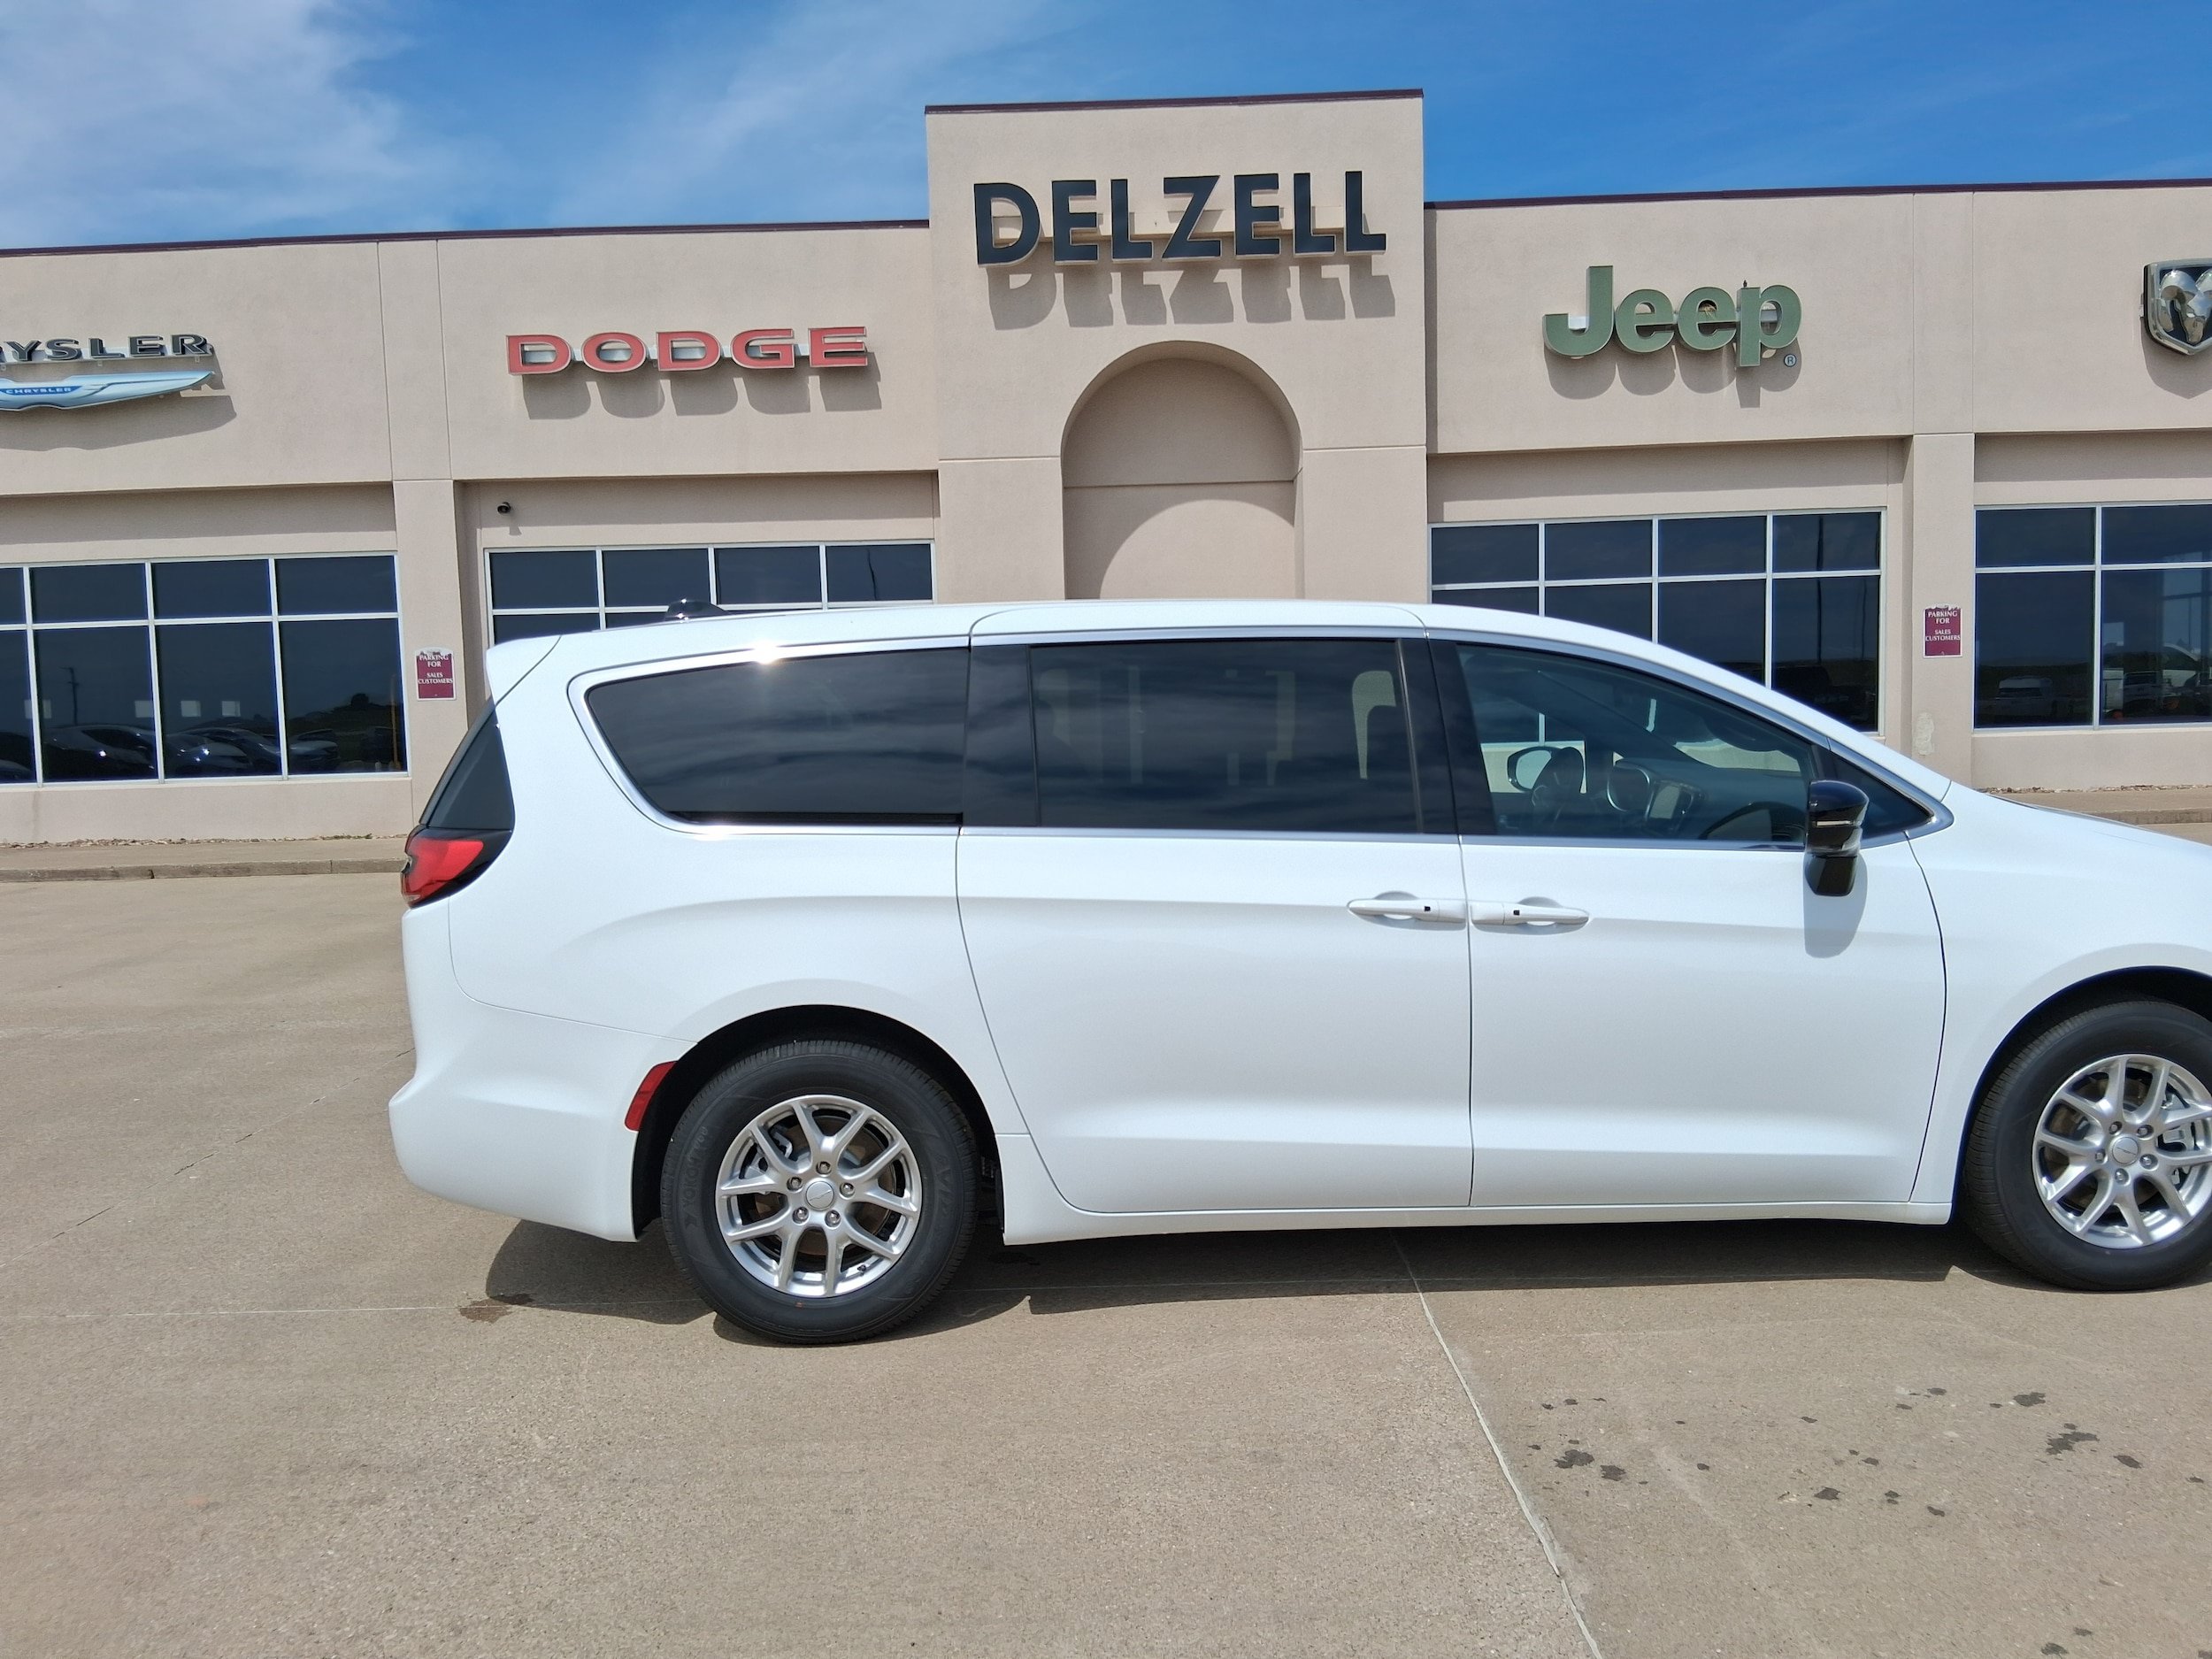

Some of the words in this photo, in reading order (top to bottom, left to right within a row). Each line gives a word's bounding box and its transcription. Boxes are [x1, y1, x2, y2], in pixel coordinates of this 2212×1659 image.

[973, 171, 1386, 267] DELZELL
[0, 334, 213, 364] YSLER
[505, 326, 868, 375] DODGE
[1542, 265, 1801, 366] Jeep
